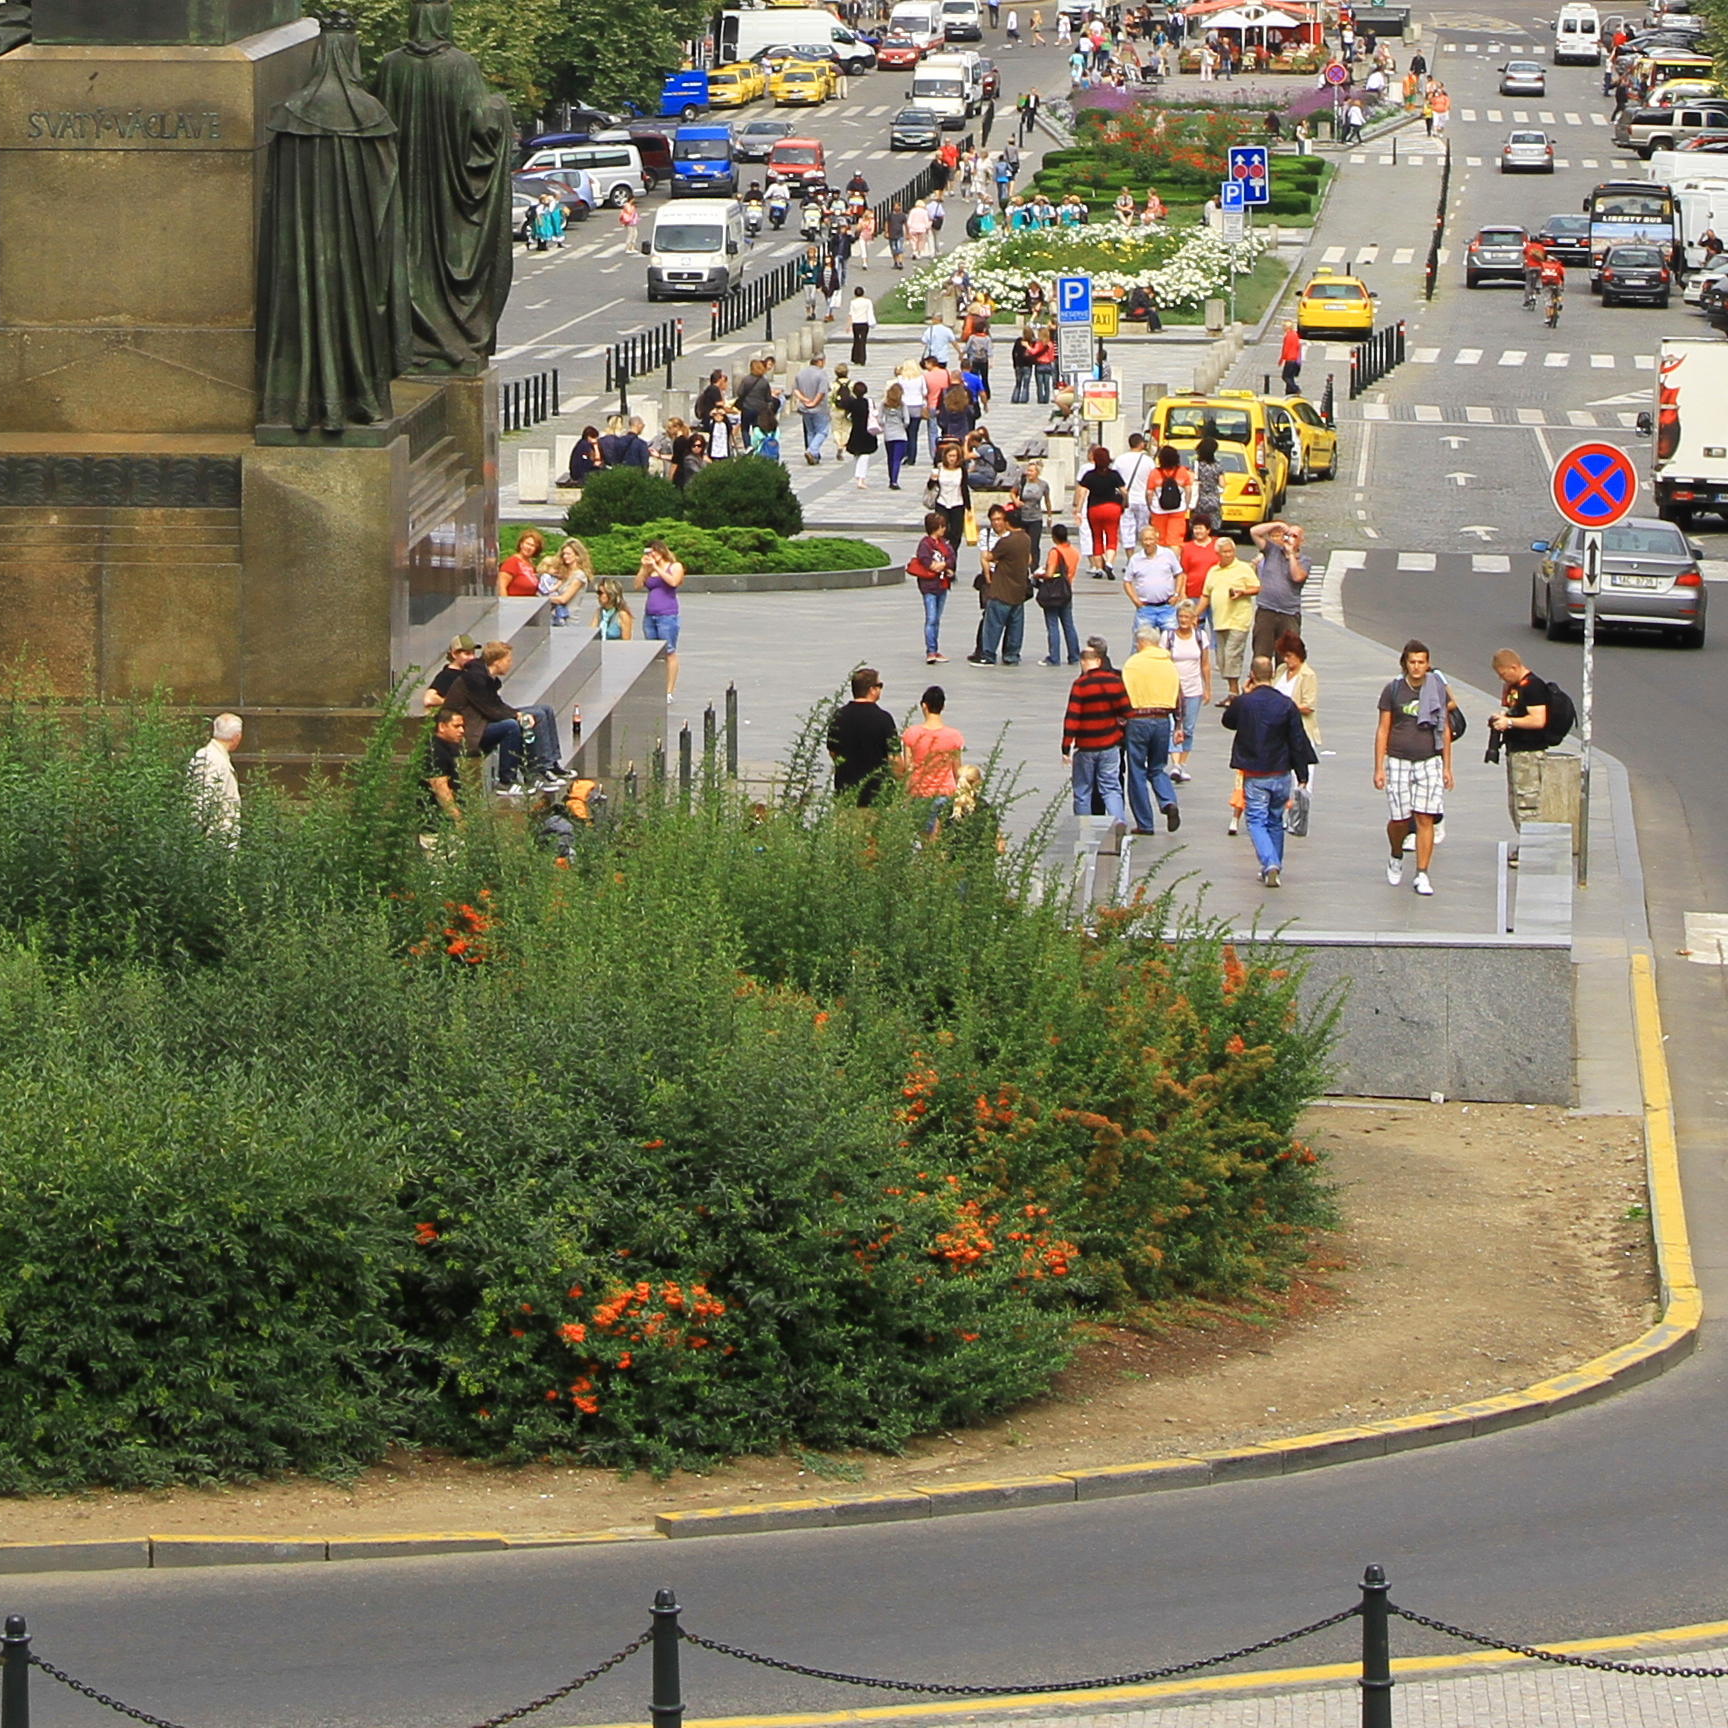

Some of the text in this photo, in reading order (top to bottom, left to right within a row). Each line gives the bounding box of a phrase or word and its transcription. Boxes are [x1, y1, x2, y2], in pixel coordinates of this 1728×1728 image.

[28, 106, 221, 139] SVATÝ VÁCLAVE
[1226, 185, 1240, 203] P
[1064, 281, 1085, 309] P
